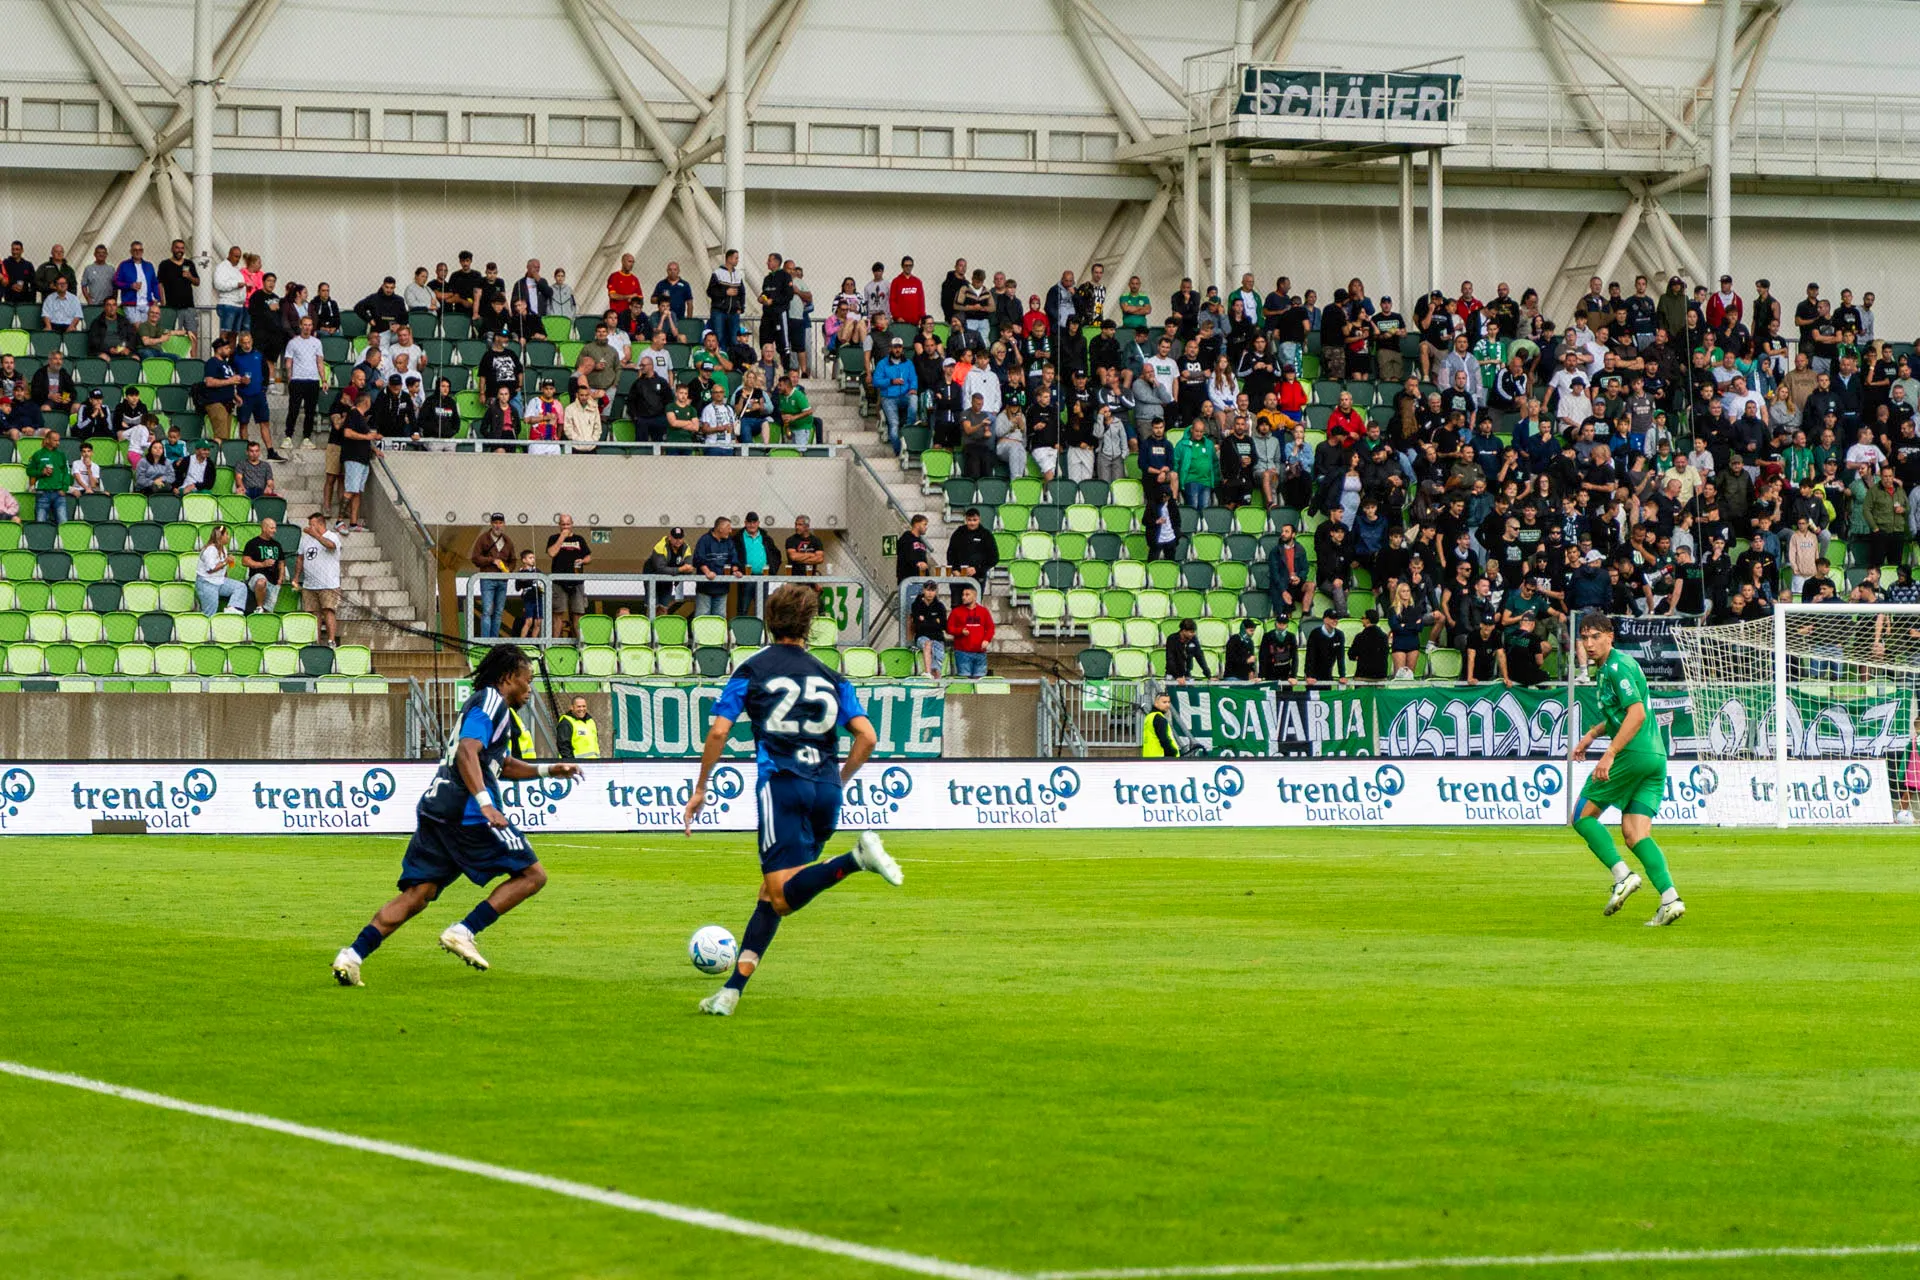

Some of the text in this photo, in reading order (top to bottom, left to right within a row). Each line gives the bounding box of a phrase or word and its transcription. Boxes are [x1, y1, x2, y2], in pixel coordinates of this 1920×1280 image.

[1249, 77, 1445, 121] SCHÄFER
[766, 676, 838, 735] 25
[1217, 697, 1366, 742] SAVARIA
[72, 780, 167, 810] trend
[252, 780, 347, 809] trend
[605, 779, 695, 807] trend
[947, 778, 1036, 806] trend
[1114, 777, 1201, 805] trend
[1276, 776, 1361, 803] trend
[1436, 776, 1520, 803] trend
[283, 810, 371, 828] burkolat
[841, 807, 890, 825] kolat
[976, 806, 1058, 824] burkolat
[1142, 805, 1223, 823] burkolat
[1306, 804, 1385, 821] burkolat
[1465, 803, 1543, 820] burkolat
[1789, 803, 1852, 819] urkolat
